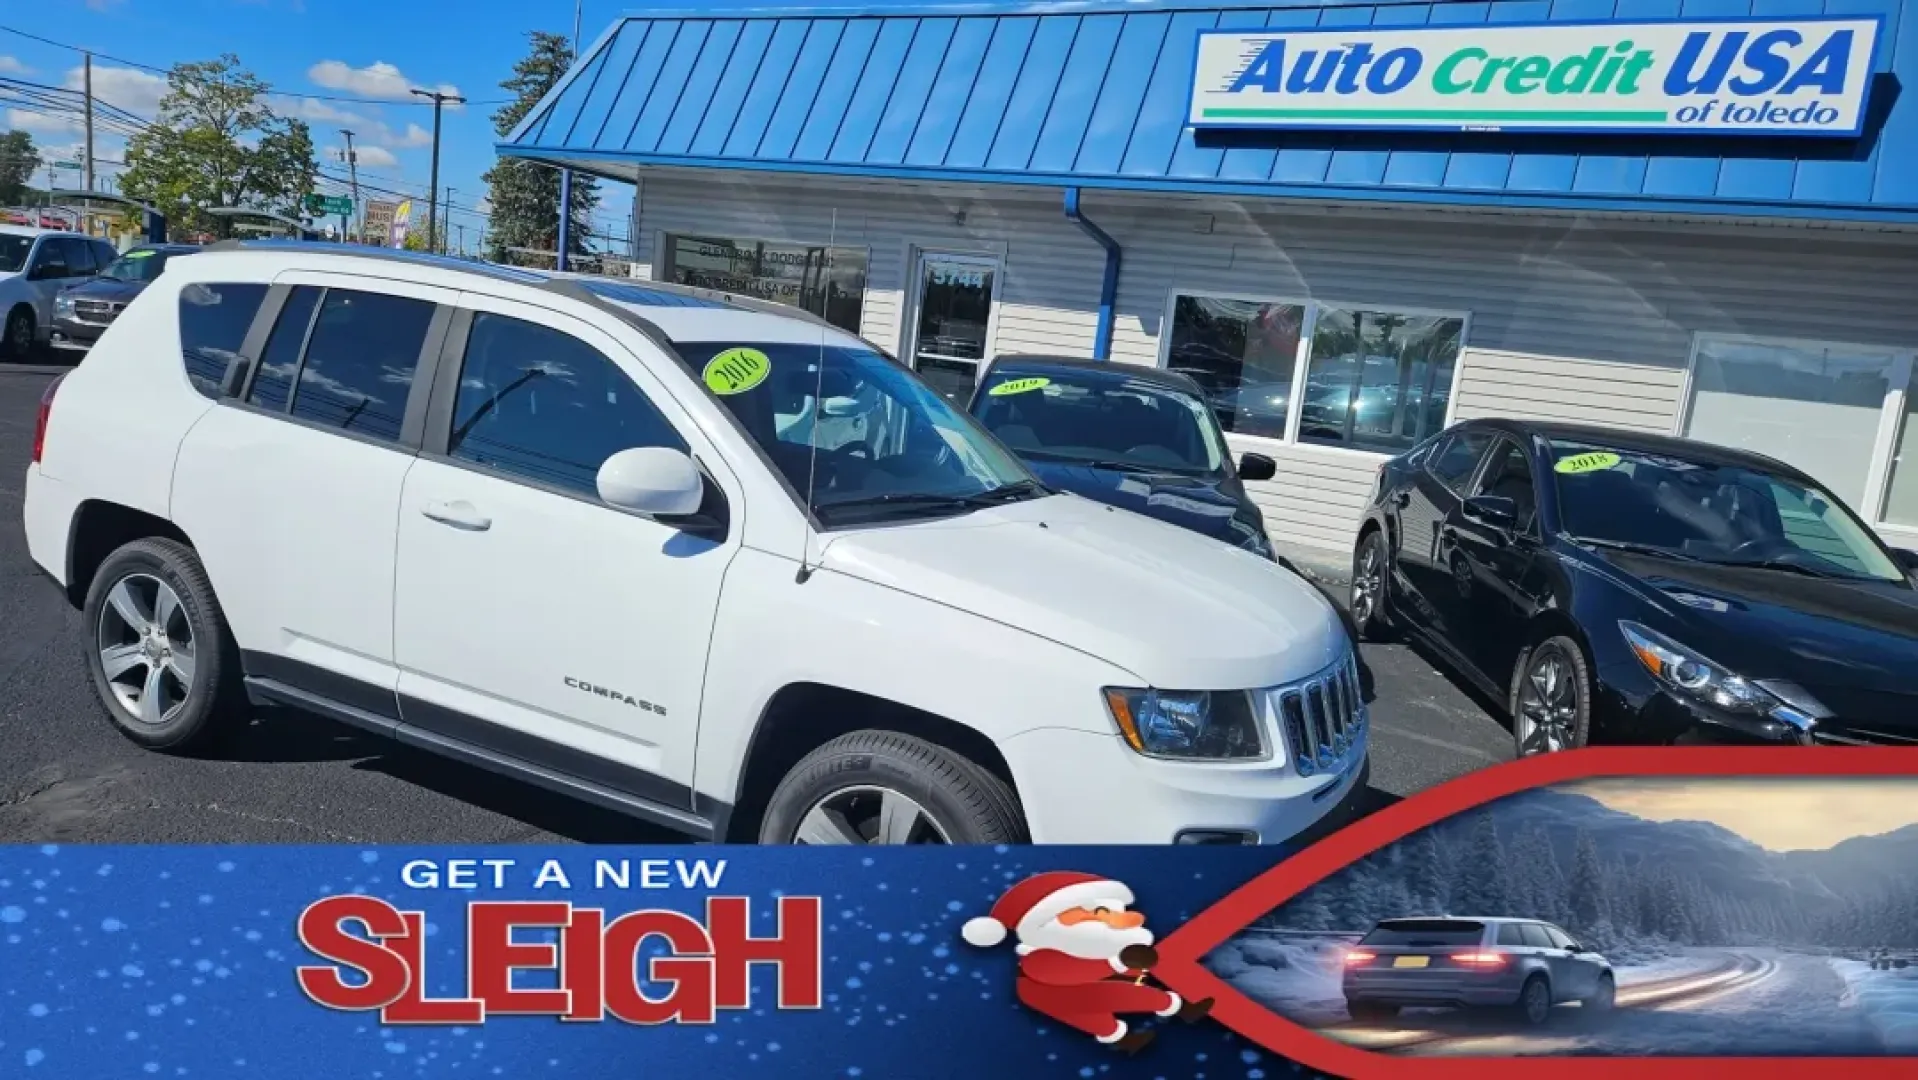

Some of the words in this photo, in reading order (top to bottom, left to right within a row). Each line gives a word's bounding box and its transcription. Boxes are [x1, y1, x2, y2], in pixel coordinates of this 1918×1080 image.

[1216, 38, 1424, 95] Auto
[1432, 40, 1655, 95] Credit
[1662, 29, 1855, 96] USA
[1675, 99, 1719, 124] of
[1721, 99, 1839, 124] toledo
[770, 250, 810, 267] DODG
[713, 350, 760, 390] 2016
[1568, 453, 1608, 471] 2018
[563, 675, 667, 717] COMPASS
